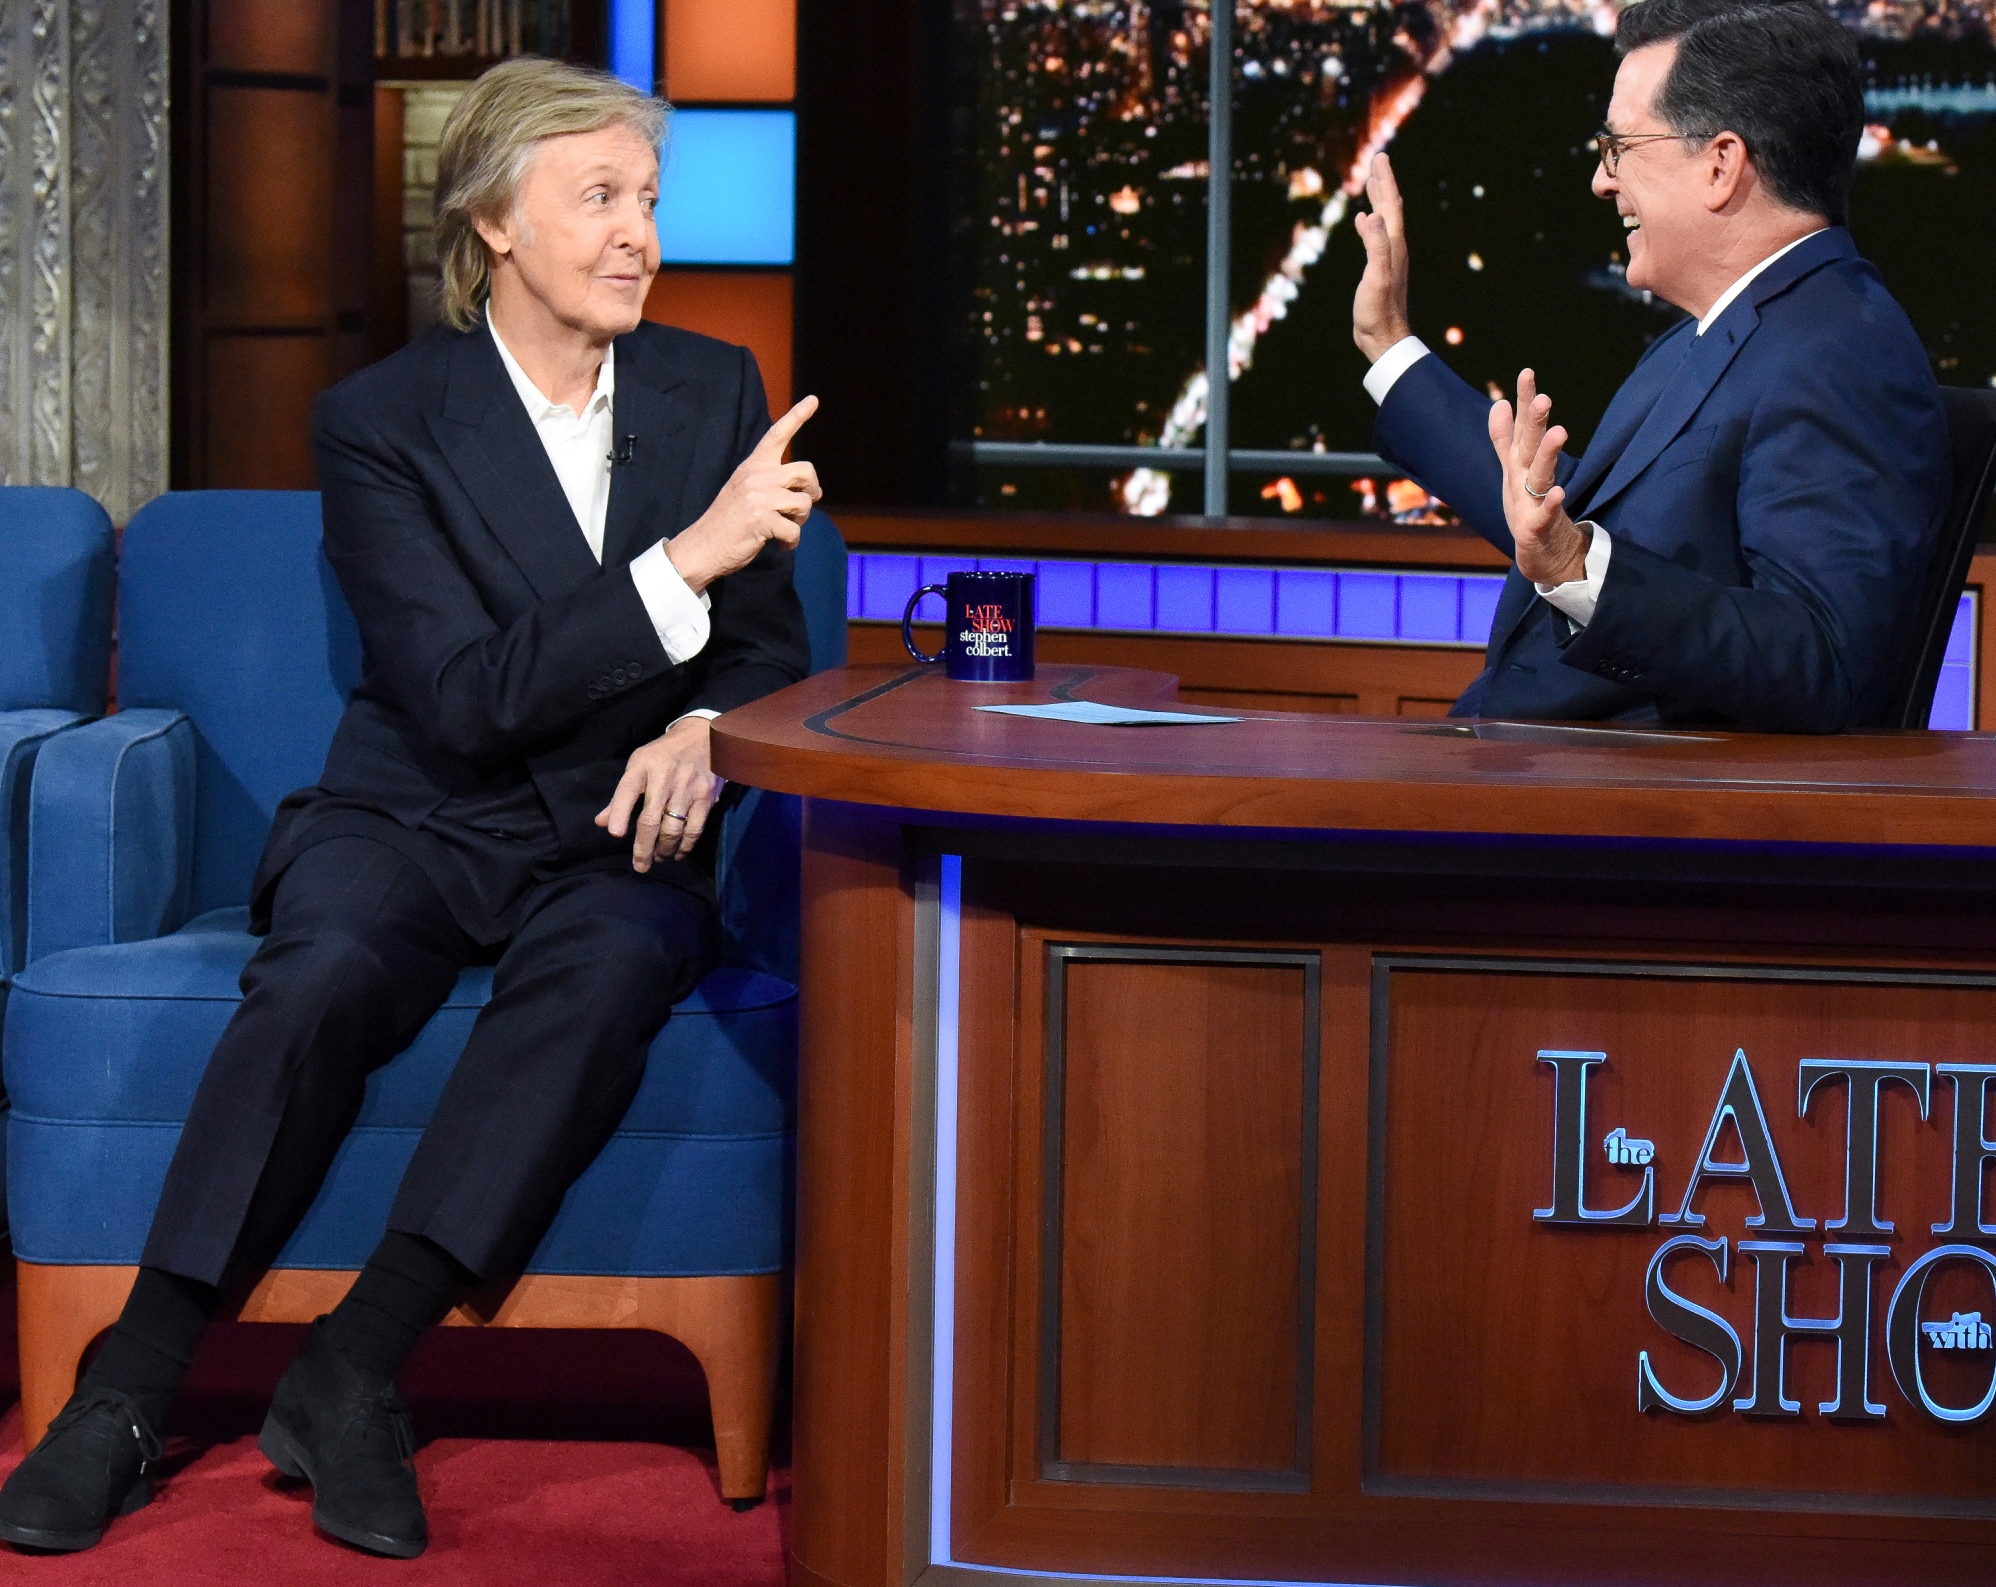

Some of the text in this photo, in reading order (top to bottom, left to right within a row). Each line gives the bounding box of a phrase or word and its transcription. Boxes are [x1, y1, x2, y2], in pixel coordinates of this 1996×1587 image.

[965, 604, 1003, 619] LATE
[971, 618, 1015, 633] SHOW
[959, 627, 1008, 648] stephen
[965, 641, 1012, 656] colbert.
[1603, 1130, 1654, 1165] the
[1922, 1315, 1994, 1349] with
